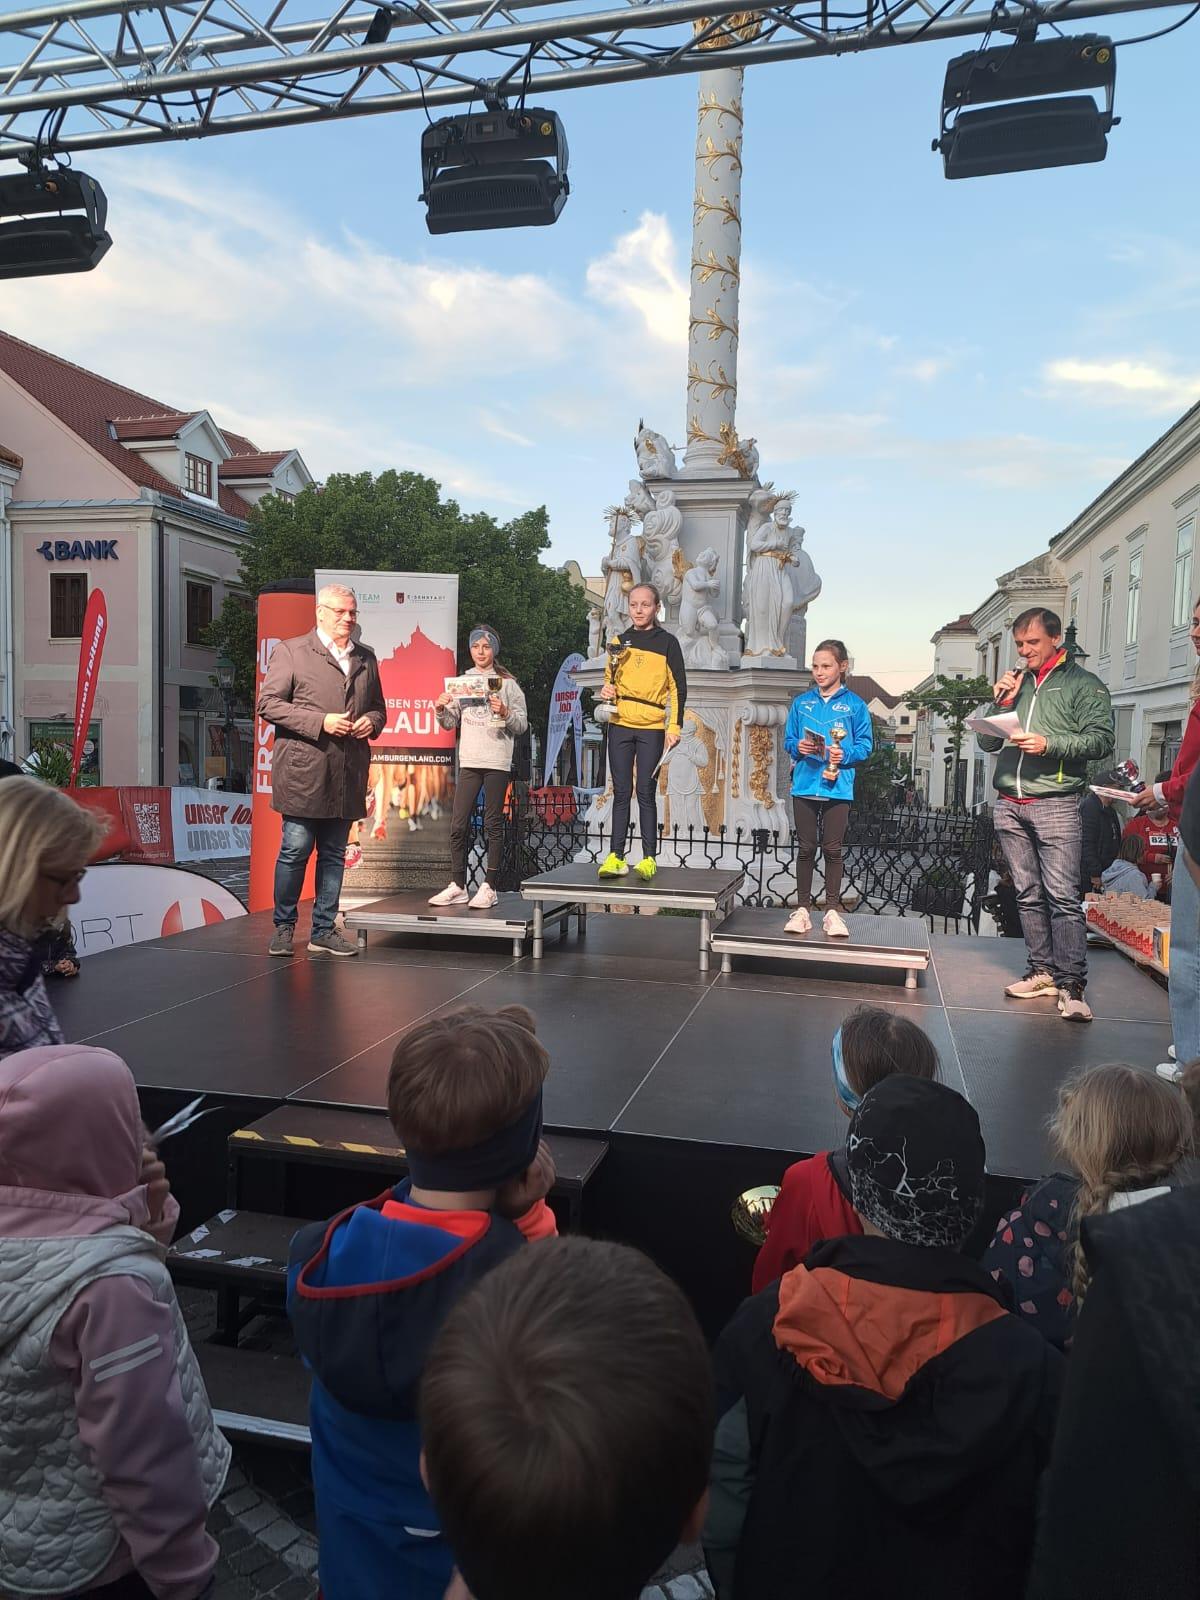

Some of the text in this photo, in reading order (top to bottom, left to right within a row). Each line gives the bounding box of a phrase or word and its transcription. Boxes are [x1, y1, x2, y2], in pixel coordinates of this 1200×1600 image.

[54, 540, 119, 560] BANK
[385, 698, 436, 710] ISEN STA
[555, 690, 579, 702] unser
[370, 754, 452, 763] AMBURGENLAND.COM
[184, 803, 229, 825] unser
[187, 829, 232, 852] unser
